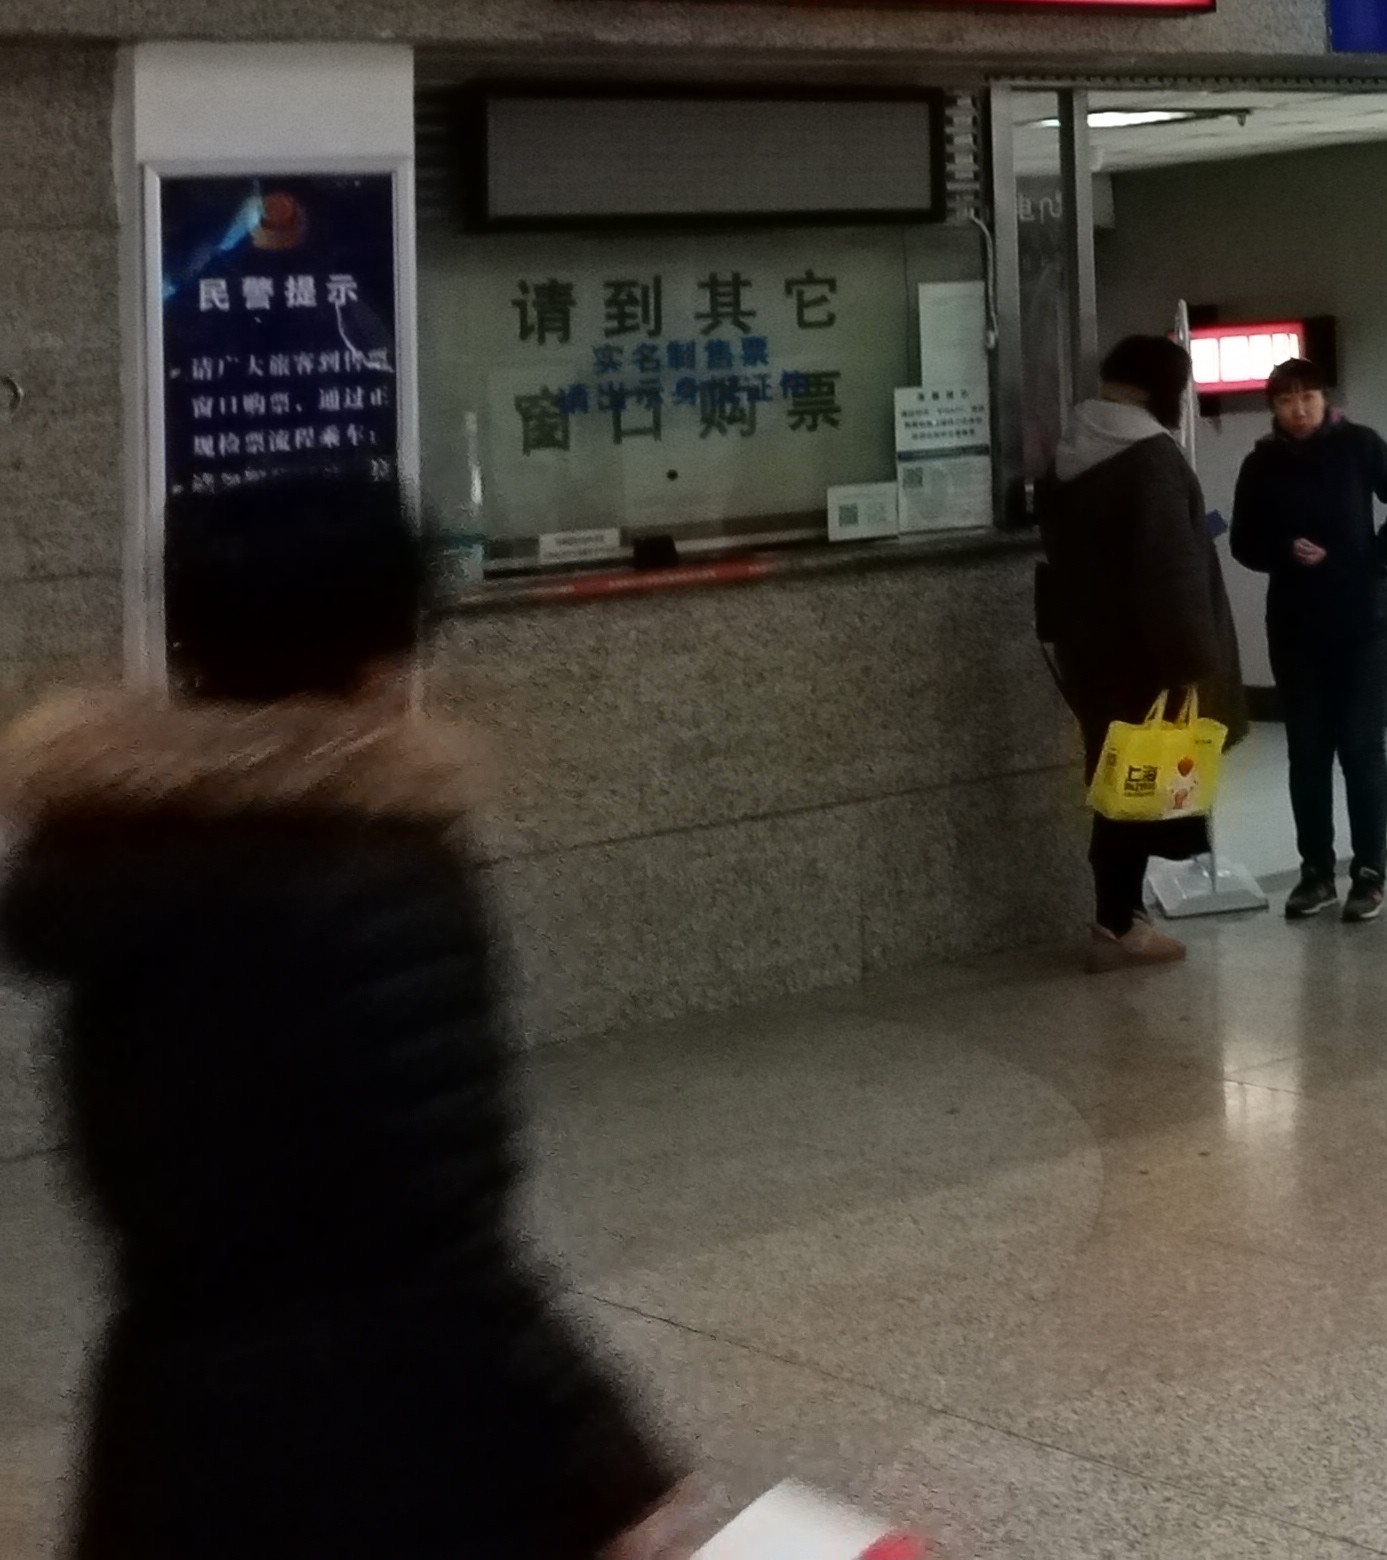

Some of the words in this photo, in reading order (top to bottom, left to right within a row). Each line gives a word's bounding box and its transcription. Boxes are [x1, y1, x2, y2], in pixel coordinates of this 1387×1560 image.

[200, 275, 357, 312] 民警提示
[512, 269, 838, 346] 请到其它
